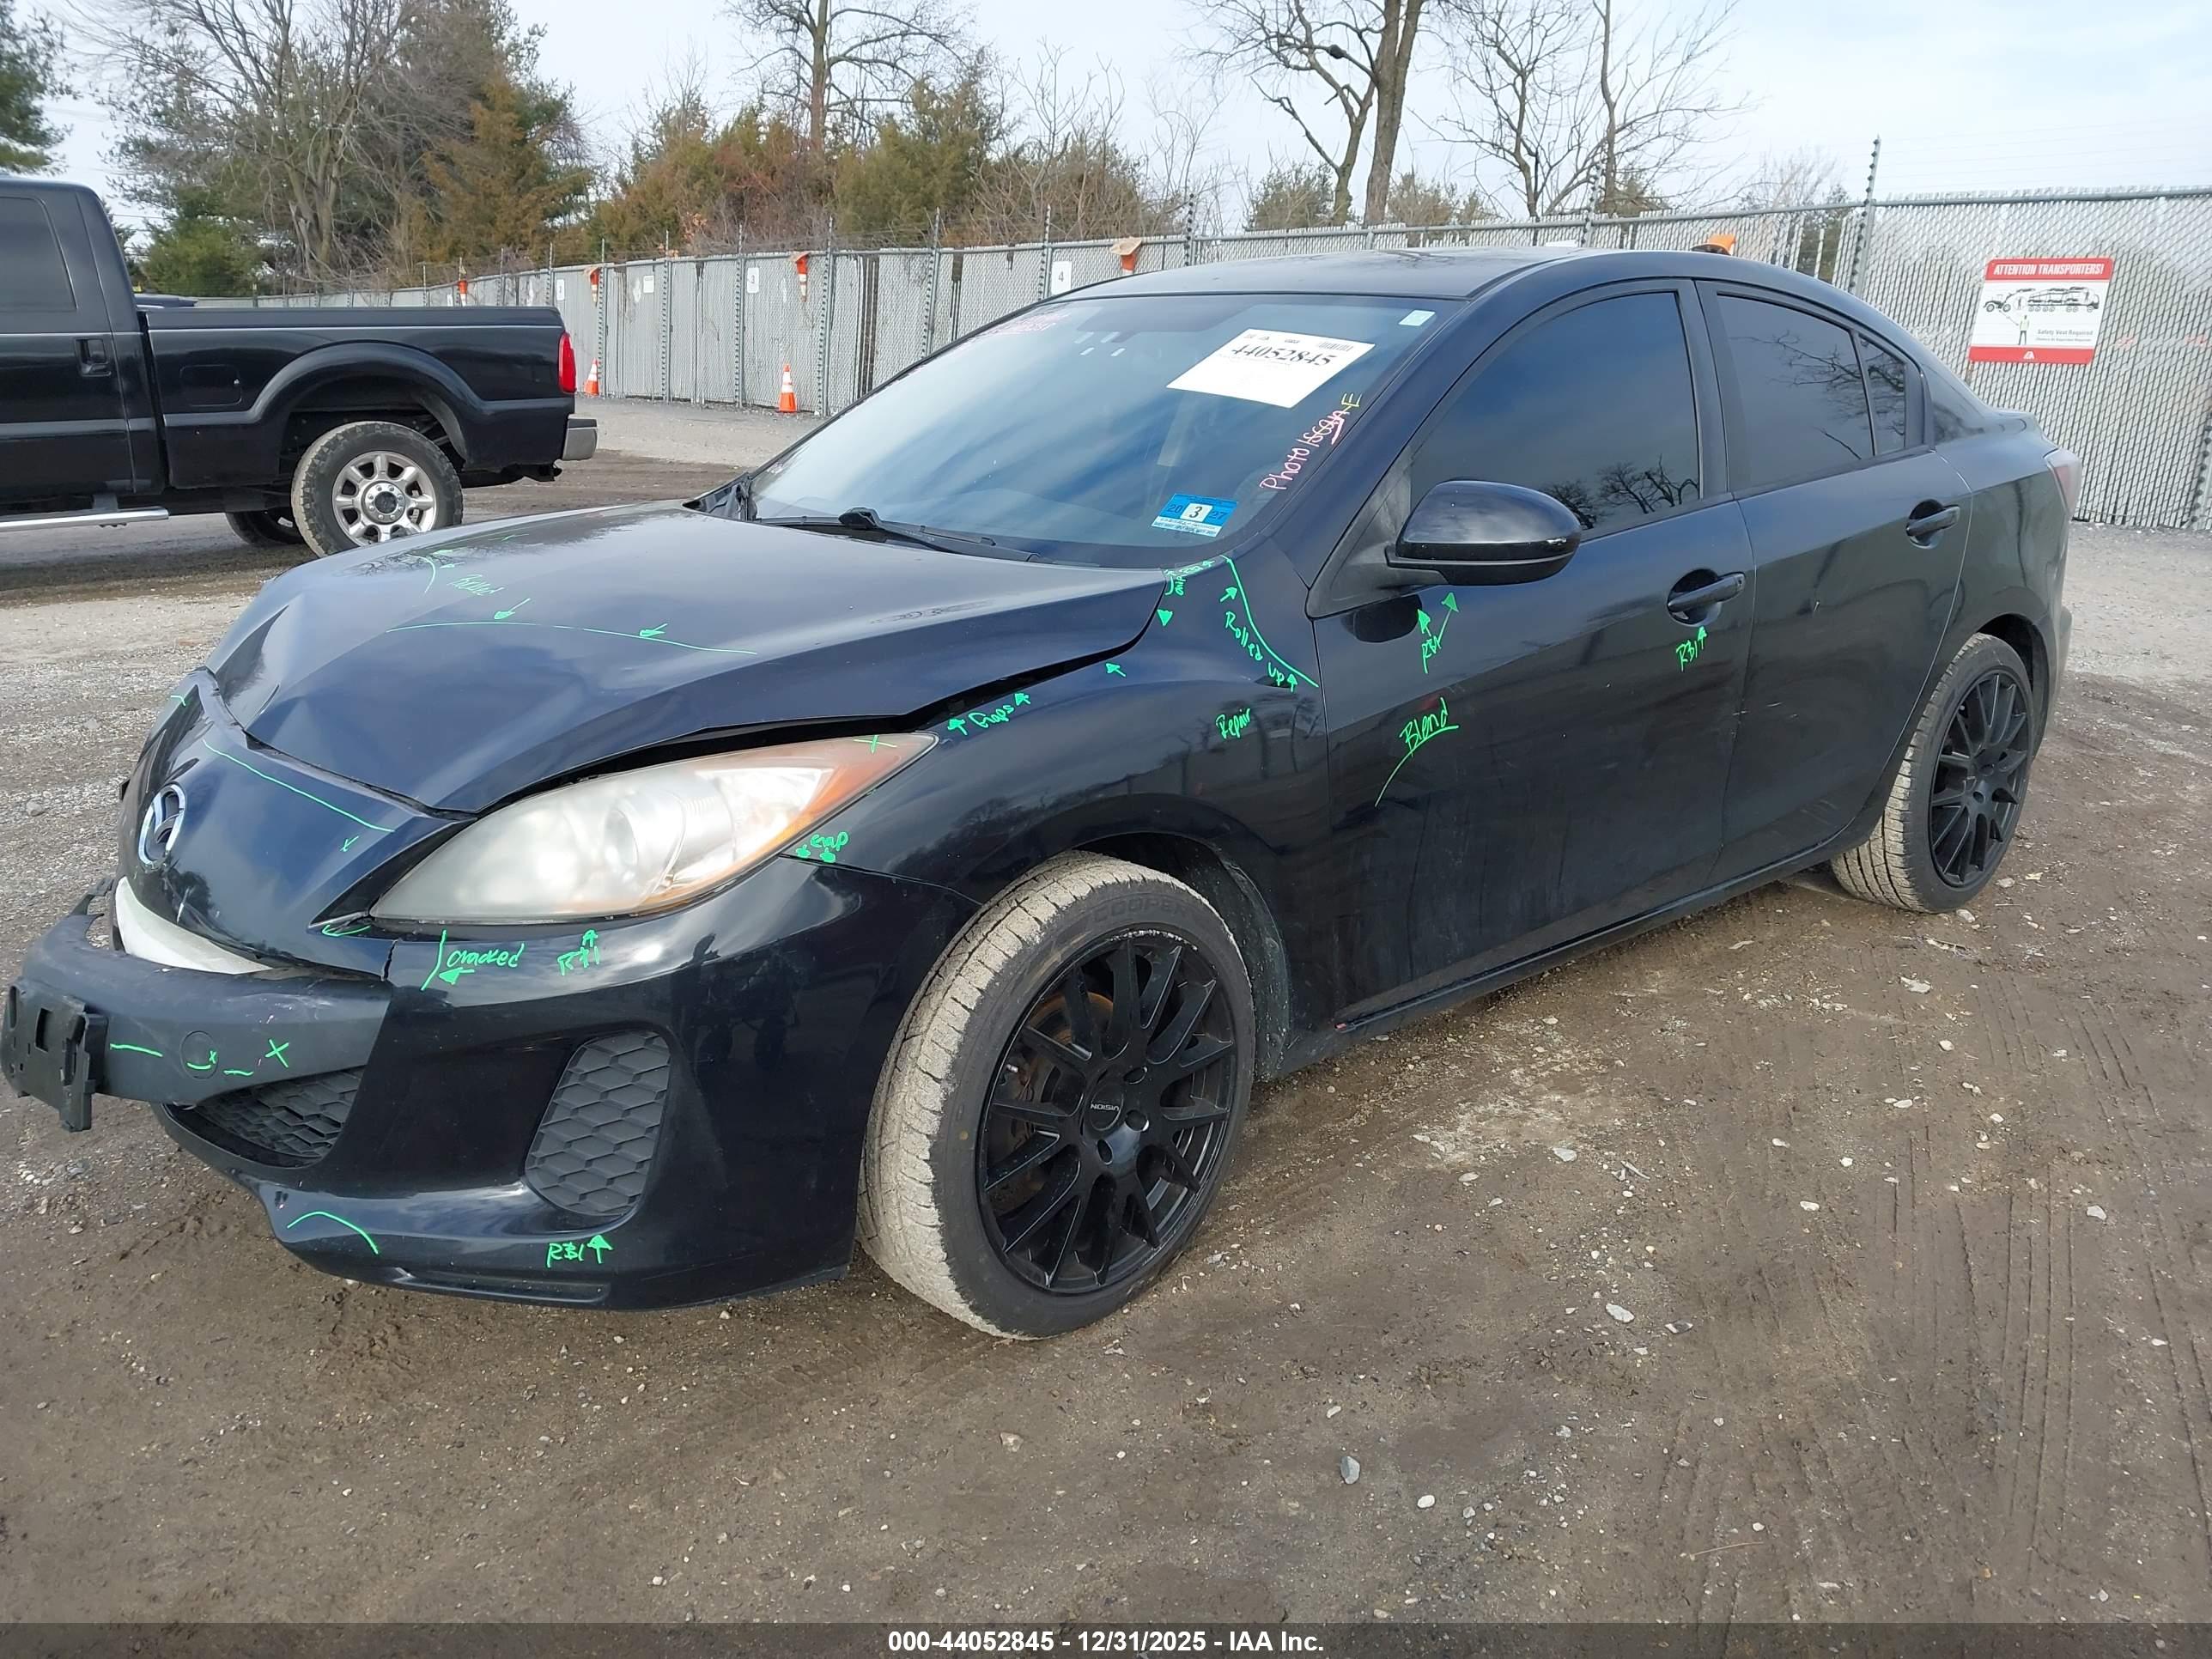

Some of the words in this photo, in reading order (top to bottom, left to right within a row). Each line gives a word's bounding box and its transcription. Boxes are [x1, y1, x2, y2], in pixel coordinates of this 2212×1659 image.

[1058, 271, 1065, 283] 4
[1994, 264, 2037, 275] ATTENTION
[2039, 263, 2105, 275] TRANSPORTERS!
[1231, 344, 1337, 366] 44052845
[1260, 447, 1310, 489] Photo
[1168, 504, 1182, 514] 20
[1188, 506, 1203, 518] 3
[1225, 611, 1263, 660] Rolled
[1400, 697, 1449, 754] Blend
